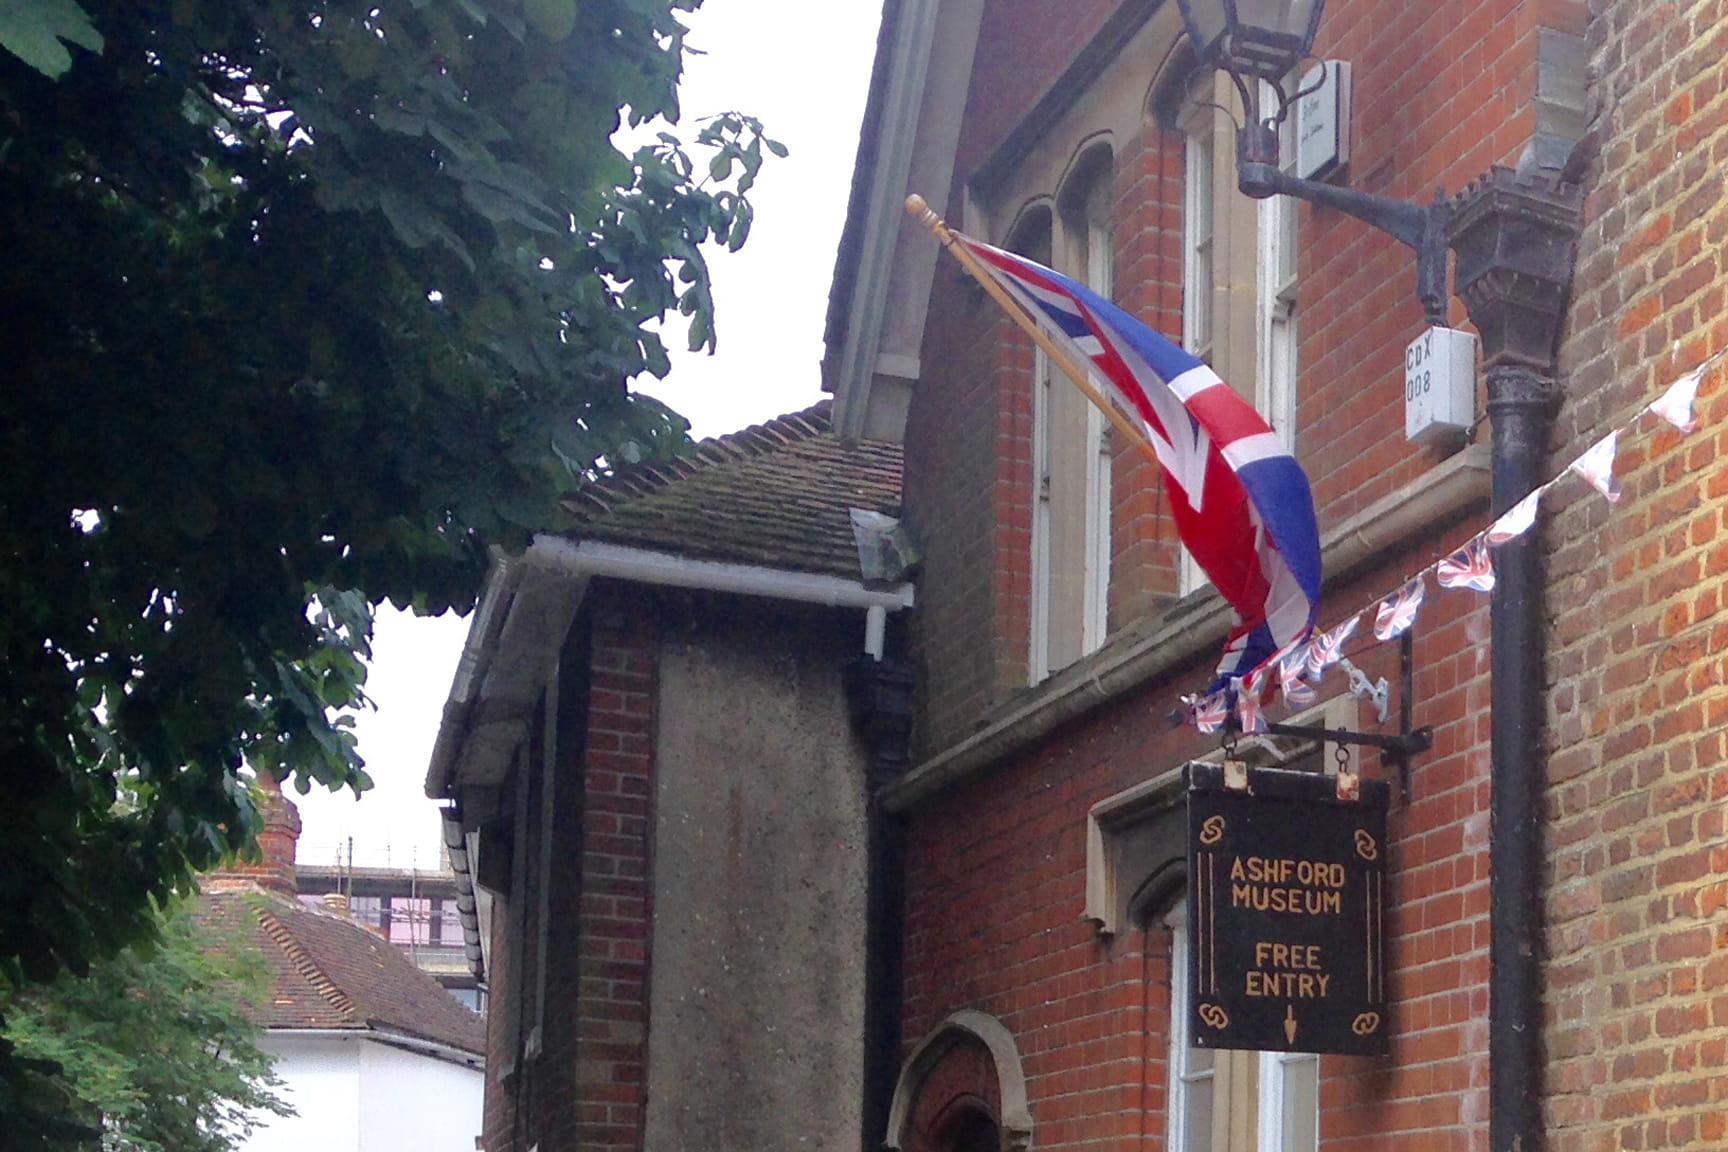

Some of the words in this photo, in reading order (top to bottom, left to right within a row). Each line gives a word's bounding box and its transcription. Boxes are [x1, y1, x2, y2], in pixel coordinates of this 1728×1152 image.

[1406, 335, 1431, 371] CDX
[1406, 369, 1431, 402] 008
[1230, 856, 1345, 888] ASHFORD
[1231, 883, 1341, 915] MUSEUM
[1255, 942, 1322, 970] FREE
[1245, 970, 1331, 999] ENTRY
